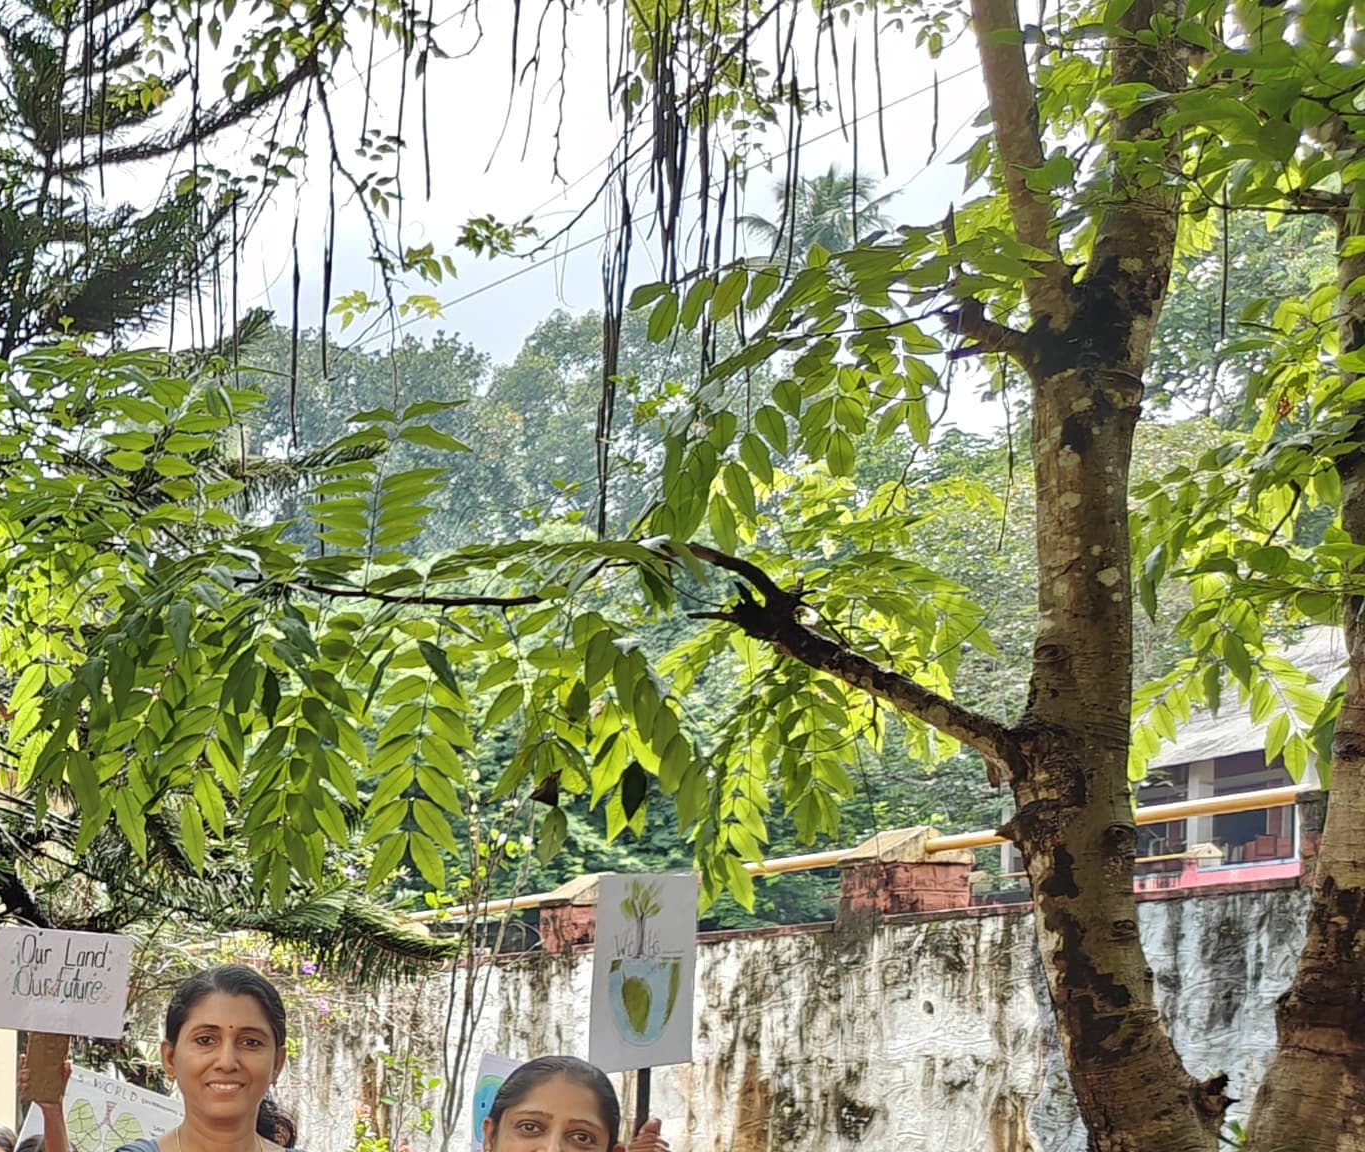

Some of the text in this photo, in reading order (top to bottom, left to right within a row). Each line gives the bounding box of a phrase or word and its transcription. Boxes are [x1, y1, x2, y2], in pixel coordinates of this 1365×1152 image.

[21, 934, 109, 968] Our Land
[15, 965, 52, 996] Our
[93, 1077, 138, 1102] WORLD
